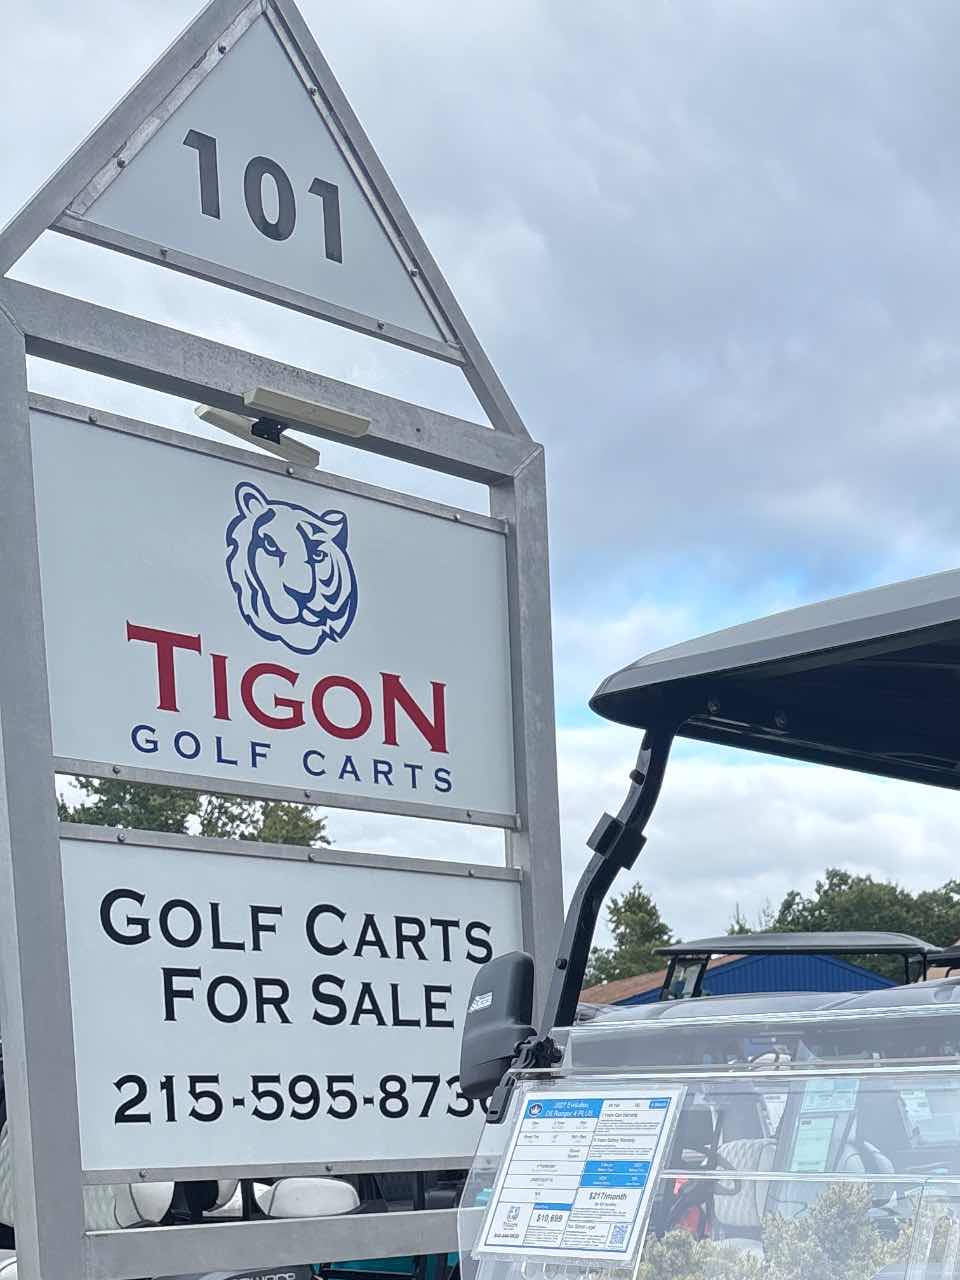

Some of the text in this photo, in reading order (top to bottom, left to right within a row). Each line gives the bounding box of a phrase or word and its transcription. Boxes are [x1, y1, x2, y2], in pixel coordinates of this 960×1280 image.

[183, 129, 343, 264] 101
[126, 620, 450, 754] TIGON
[130, 724, 454, 793] GOLF CARTS
[99, 888, 494, 965] GOLF CARTS
[161, 967, 456, 1029] FOR SALE
[112, 1073, 489, 1125] 215-595-873
